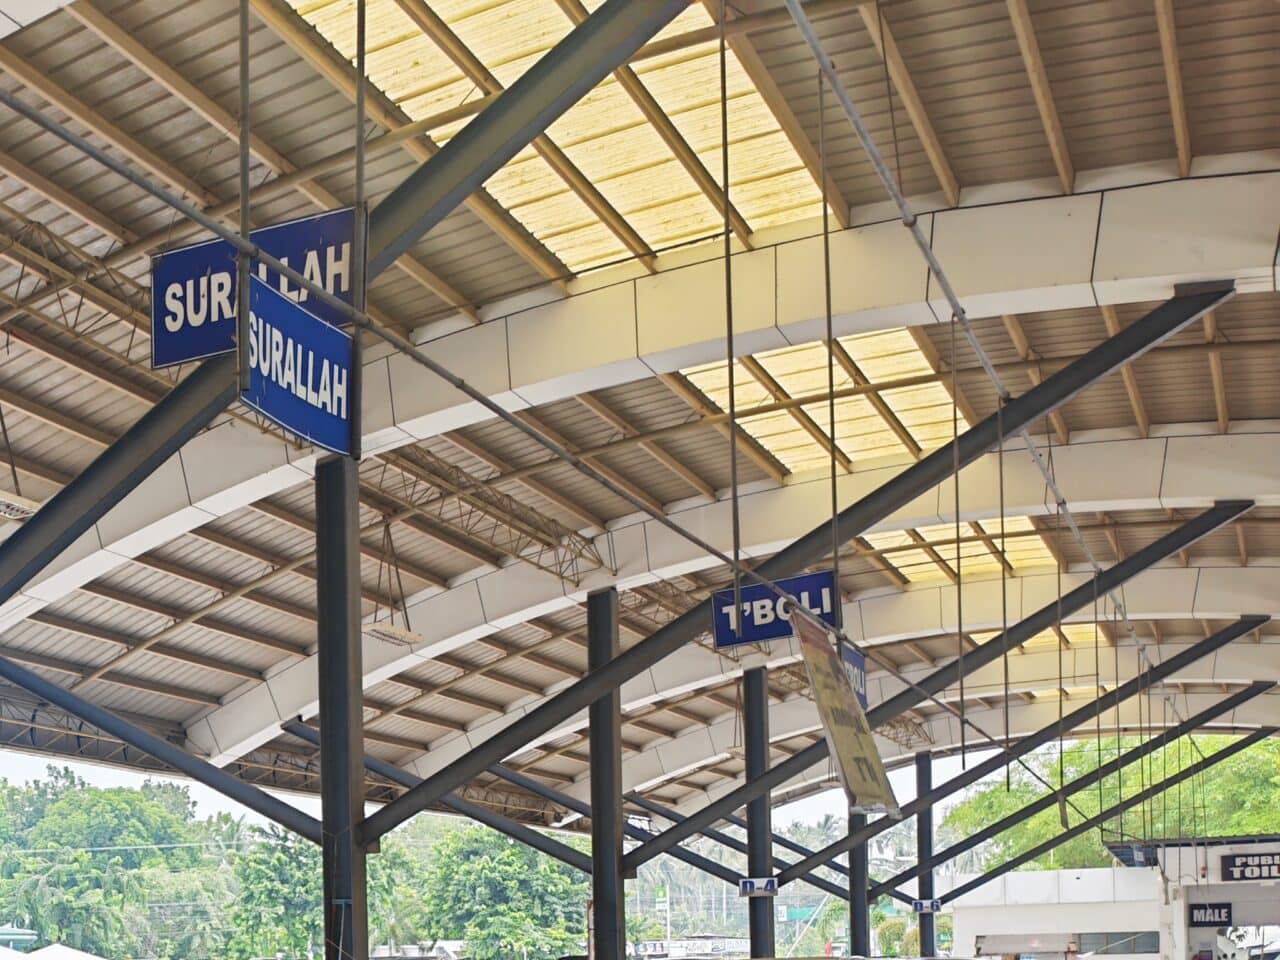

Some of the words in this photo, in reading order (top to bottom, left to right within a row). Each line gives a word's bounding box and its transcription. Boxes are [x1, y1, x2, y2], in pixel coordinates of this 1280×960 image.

[164, 242, 351, 332] SURLAH
[249, 311, 348, 420] SURALLAH
[1193, 908, 1229, 923] MALE
